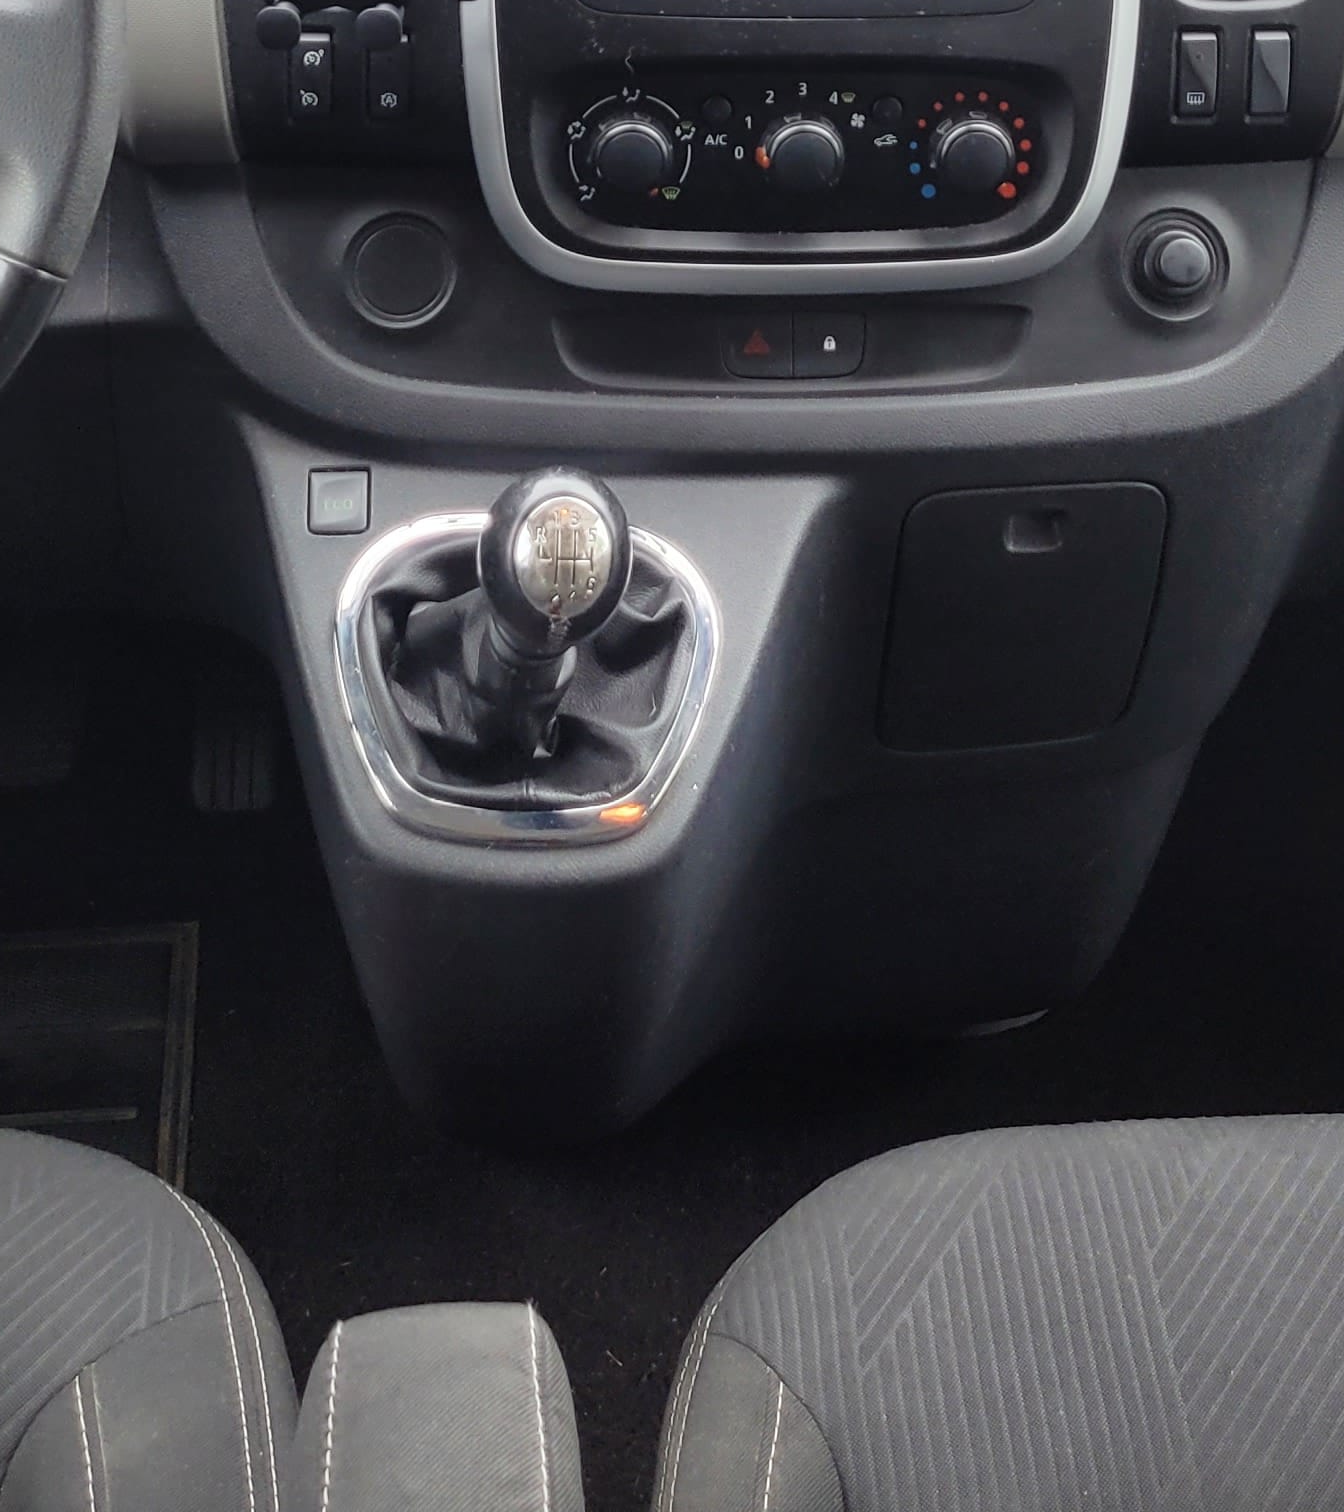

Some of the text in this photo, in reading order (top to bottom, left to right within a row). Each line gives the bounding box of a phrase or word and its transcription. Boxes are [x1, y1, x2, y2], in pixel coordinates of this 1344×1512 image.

[798, 82, 807, 96] 3
[765, 90, 775, 104] 2
[829, 91, 839, 105] 4
[744, 115, 753, 130] 1
[704, 133, 728, 146] A/C
[534, 527, 547, 544] R
[588, 527, 598, 543] 5
